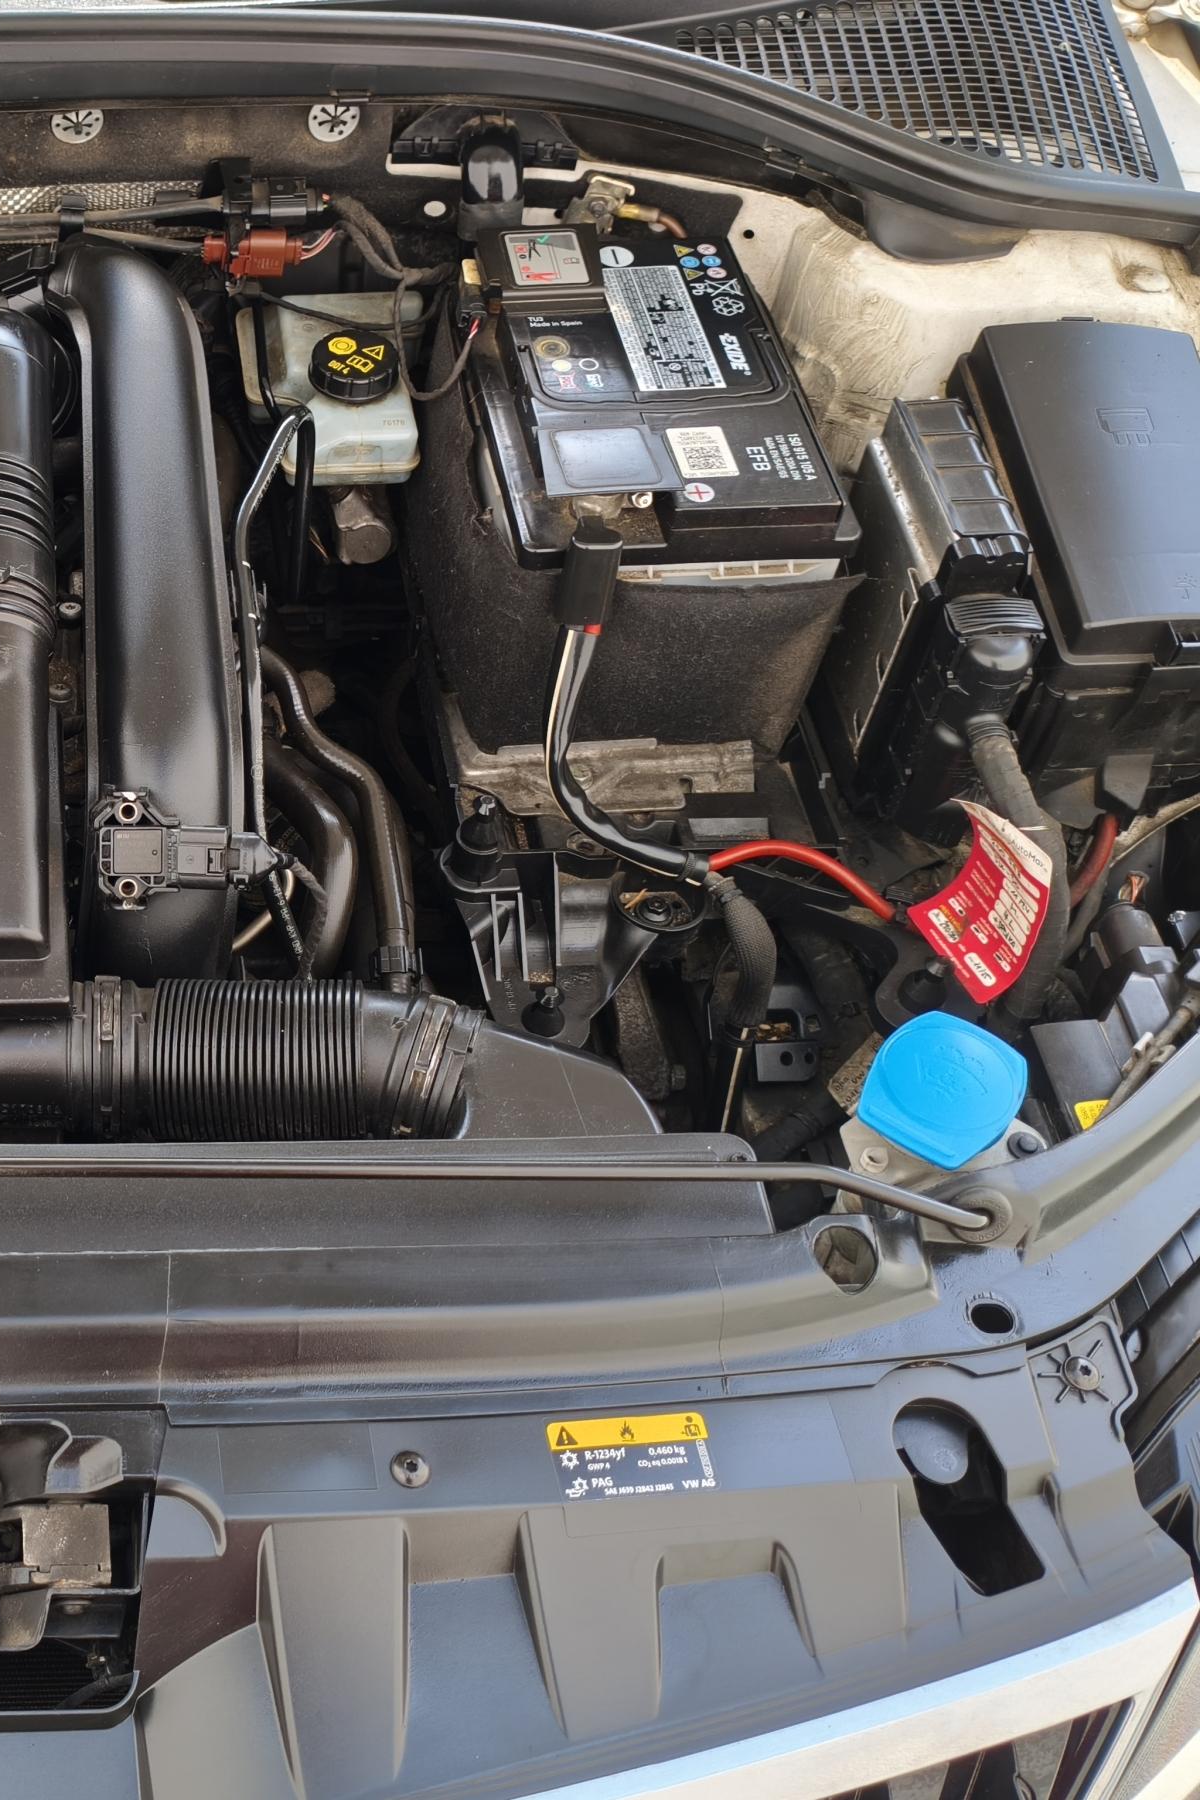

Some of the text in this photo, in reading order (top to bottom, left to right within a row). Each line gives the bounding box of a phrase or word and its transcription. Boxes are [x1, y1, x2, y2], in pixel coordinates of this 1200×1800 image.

[718, 332, 746, 372] EXIDE
[328, 360, 345, 371] DOT
[746, 446, 771, 471] EFB
[792, 447, 808, 459] 915
[798, 461, 814, 473] 105
[584, 1447, 625, 1460] R-1234yf
[674, 1445, 686, 1455] kg
[592, 1477, 613, 1488] PAG
[682, 1478, 716, 1488] VW AG
